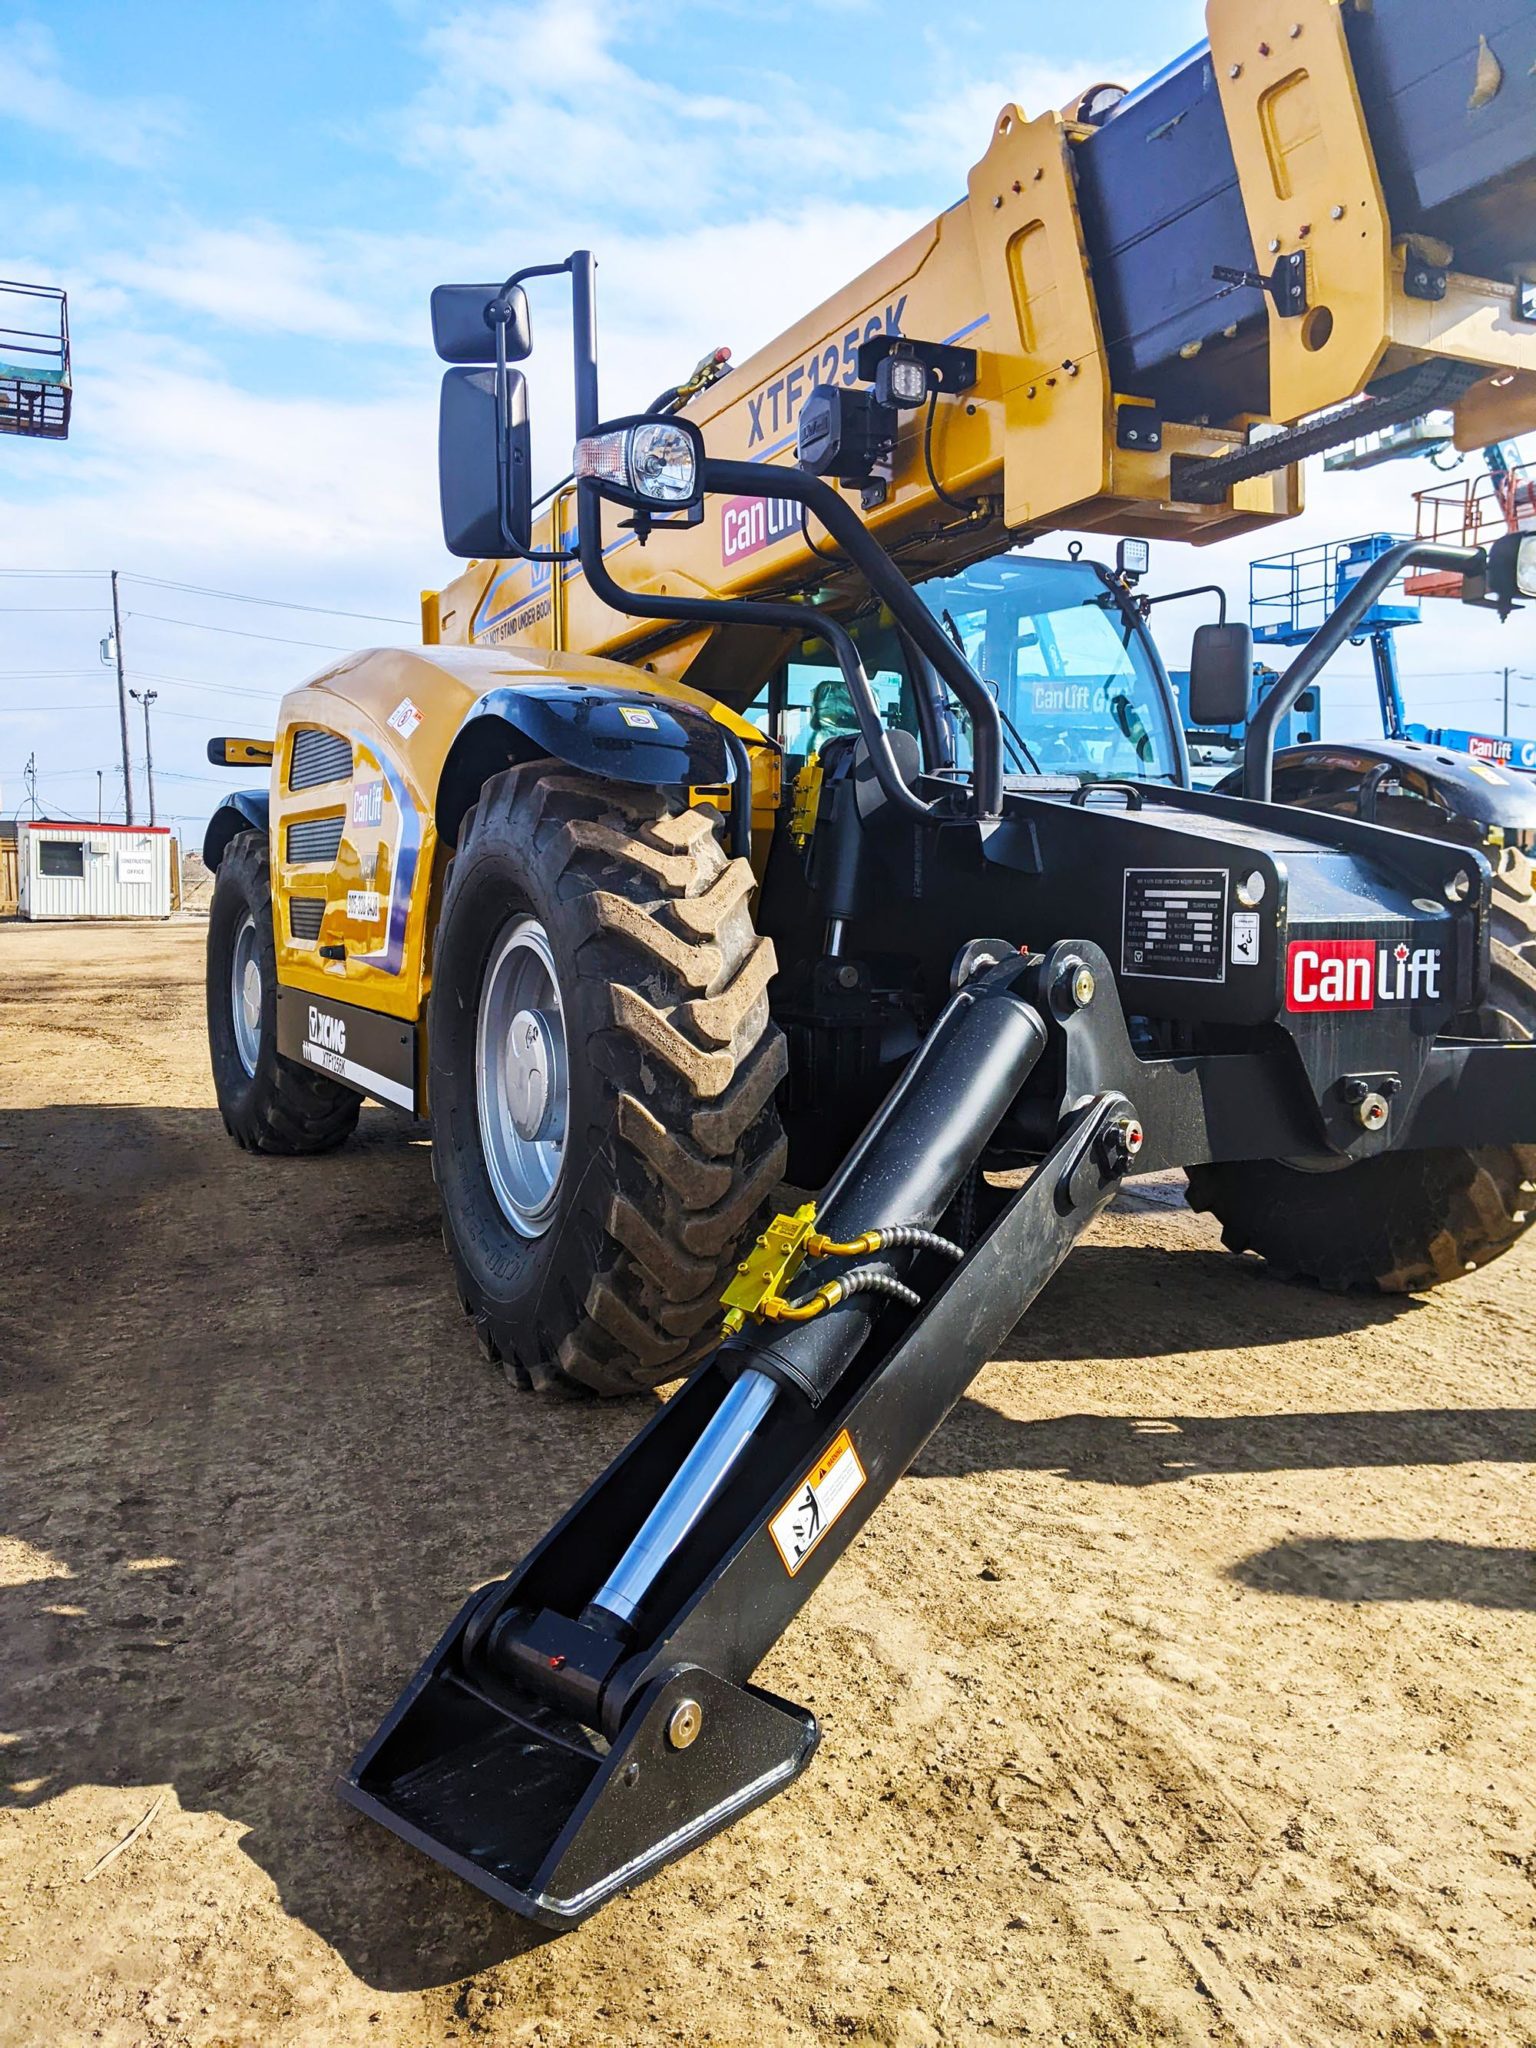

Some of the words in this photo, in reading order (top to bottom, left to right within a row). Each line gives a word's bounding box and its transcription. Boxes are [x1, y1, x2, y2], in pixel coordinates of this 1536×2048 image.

[500, 618, 517, 640] STAND
[518, 607, 536, 631] UNDER
[317, 1012, 346, 1054] XCMG
